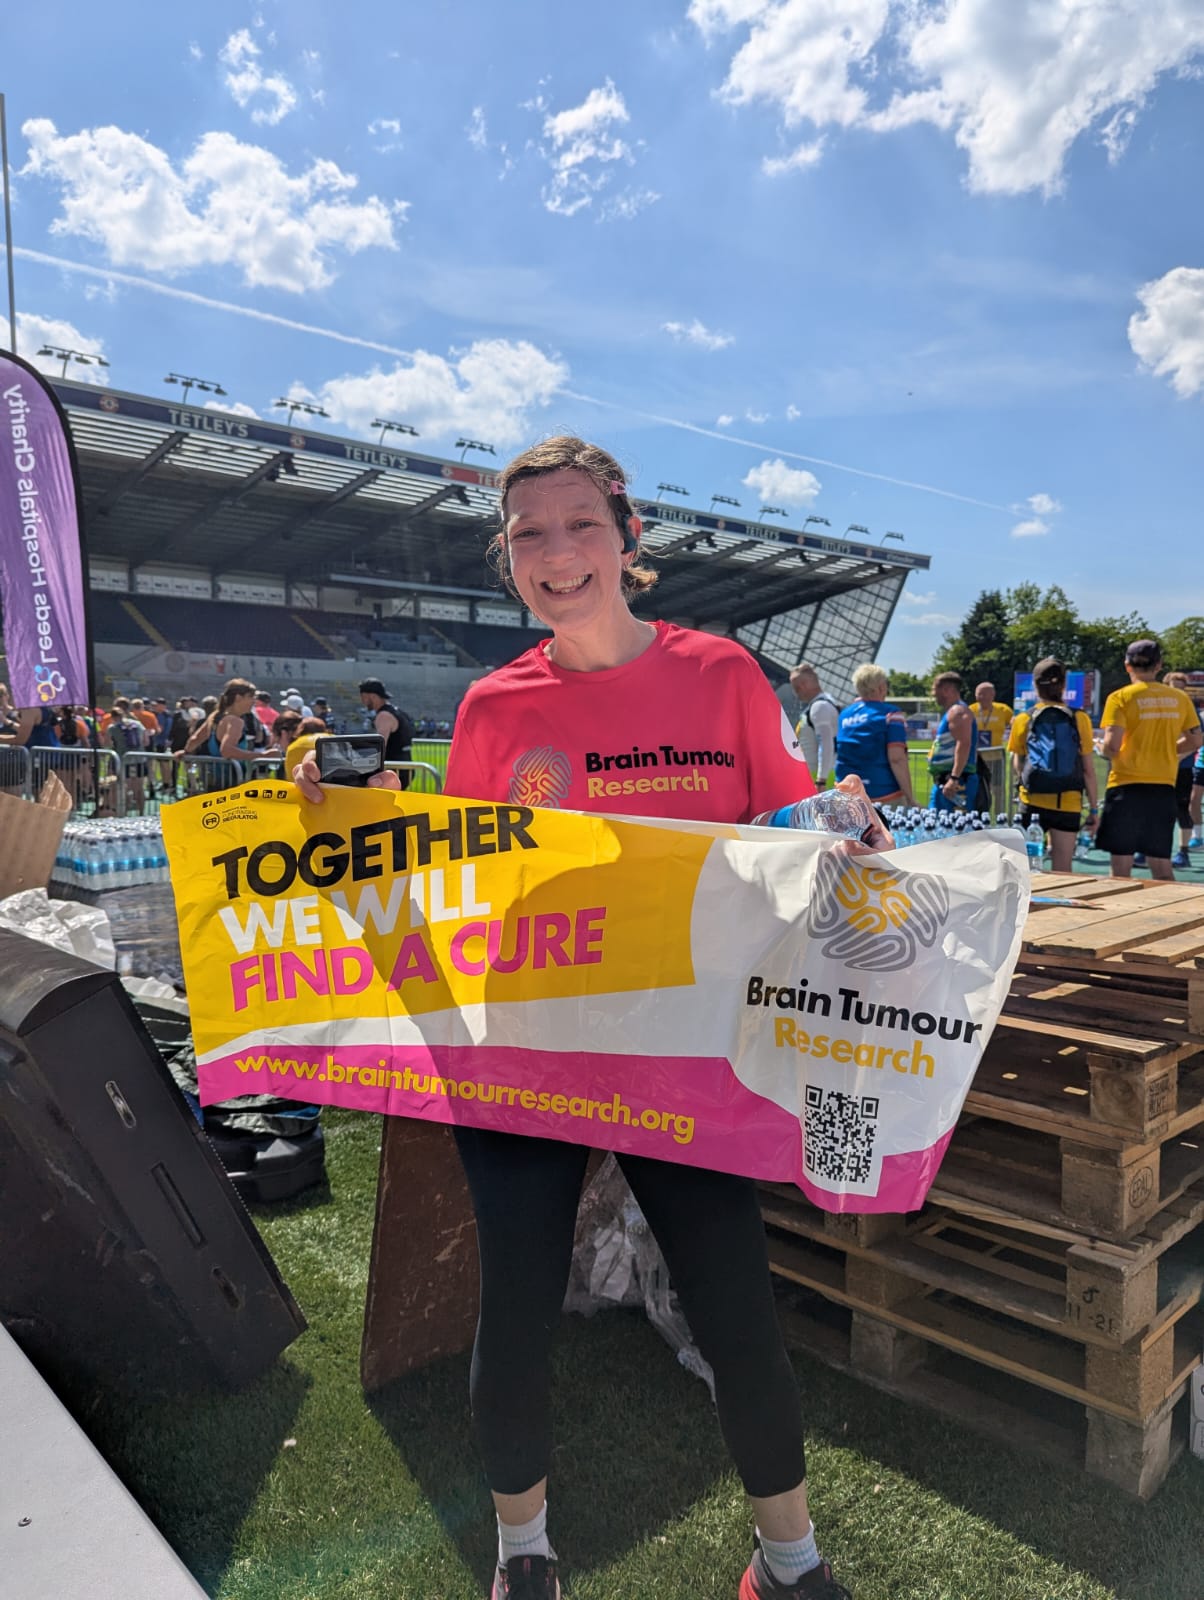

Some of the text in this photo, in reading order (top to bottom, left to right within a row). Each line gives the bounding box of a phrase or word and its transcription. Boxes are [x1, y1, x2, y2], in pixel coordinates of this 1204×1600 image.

[168, 408, 249, 437] TETLEY'S
[344, 445, 408, 470] TETLEY'S
[657, 508, 696, 525] TETLEYS
[586, 747, 658, 773] Brain
[587, 769, 709, 798] Research
[212, 806, 539, 900] TOGETHER
[219, 864, 491, 954] WE WILL
[231, 907, 607, 1012] FIND A CURE
[747, 977, 982, 1042] Brain Tumour
[774, 1018, 935, 1077] Research
[234, 1054, 695, 1144] www.braintumourresearch.org
